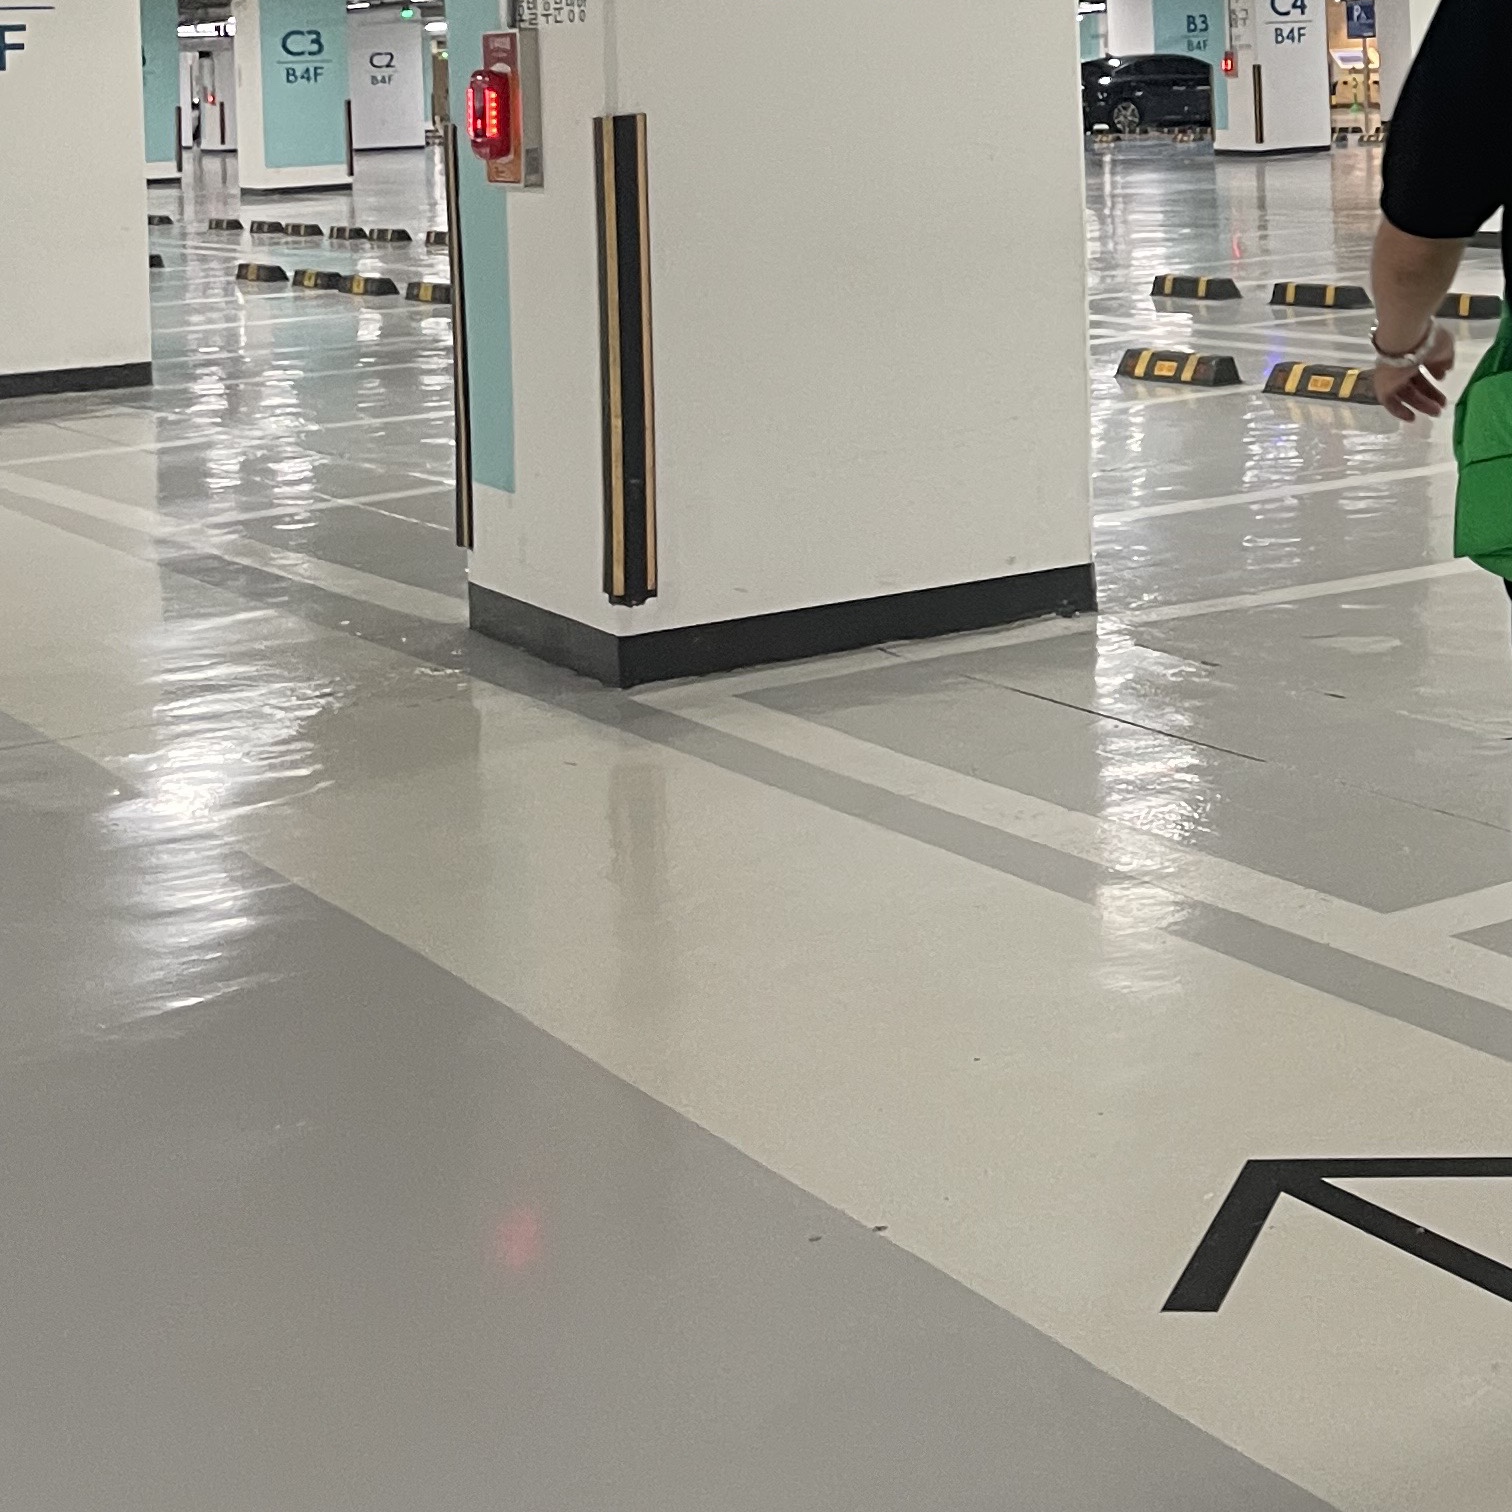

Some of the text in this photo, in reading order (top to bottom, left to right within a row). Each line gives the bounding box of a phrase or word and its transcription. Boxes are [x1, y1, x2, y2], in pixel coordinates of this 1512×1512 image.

[1186, 14, 1209, 33] B3
[281, 30, 324, 56] C3
[1274, 27, 1307, 44] B4F
[1187, 40, 1208, 51] B4F
[369, 51, 394, 68] C2
[285, 66, 324, 83] B4F
[371, 74, 394, 85] B4F
